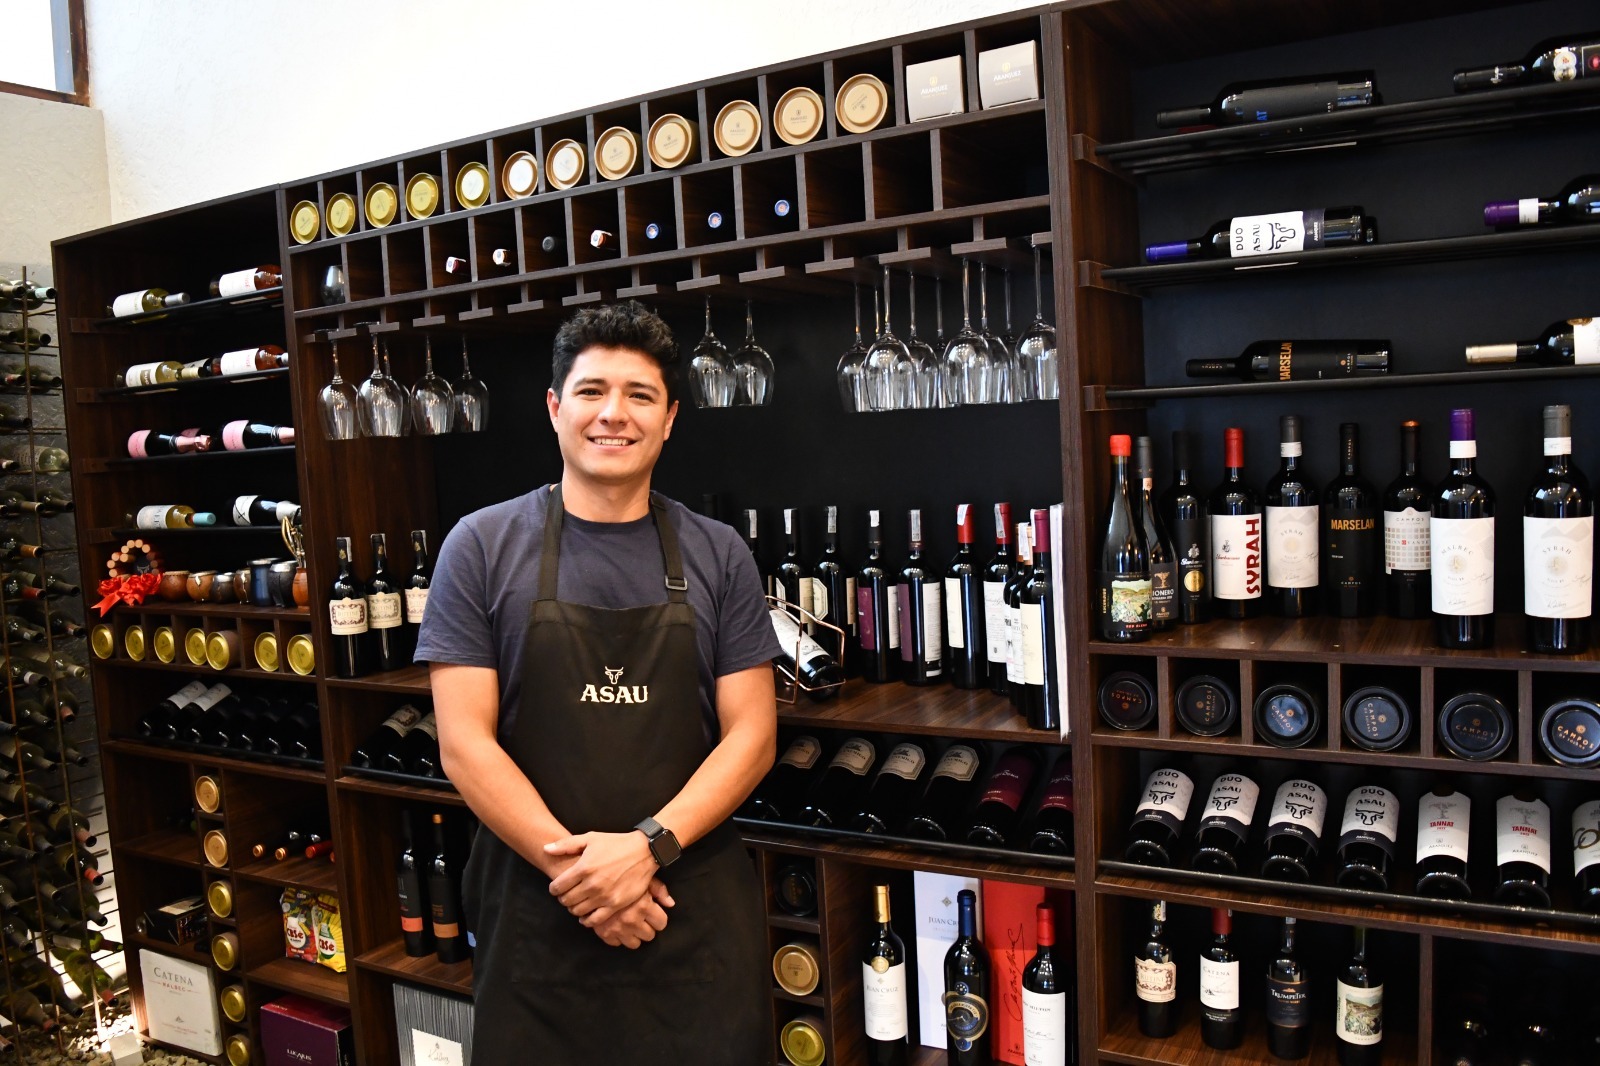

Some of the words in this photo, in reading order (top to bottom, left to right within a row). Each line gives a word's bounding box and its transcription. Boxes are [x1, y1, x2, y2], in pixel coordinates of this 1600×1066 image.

[1236, 227, 1244, 251] DUO
[1253, 224, 1261, 252] ASAU
[1330, 518, 1374, 531] MARSELAN
[1441, 545, 1474, 555] MALBEC
[1542, 546, 1572, 555] SYRAH
[1246, 518, 1260, 594] SYRAH
[580, 684, 648, 704] ASAU
[1111, 692, 1142, 704] CAMPOS
[1271, 704, 1294, 732] CAMPOS
[1367, 702, 1379, 737] CAMPOS
[1455, 724, 1495, 738] CAMPOS
[1556, 725, 1594, 750] CAMPOS
[1157, 771, 1179, 779] DUO
[1152, 780, 1178, 789] ASAU
[1292, 782, 1316, 792] DUO
[1287, 792, 1316, 803] ASAU
[1360, 788, 1384, 796] DUO
[1356, 798, 1385, 807] ASAU
[1512, 826, 1538, 835] TANNAT
[928, 916, 945, 924] JUAN
[154, 966, 193, 986] CATENA
[1203, 966, 1230, 976] CATENA
[162, 982, 186, 992] MALBEC
[1271, 989, 1306, 1000] TRUMPETER
